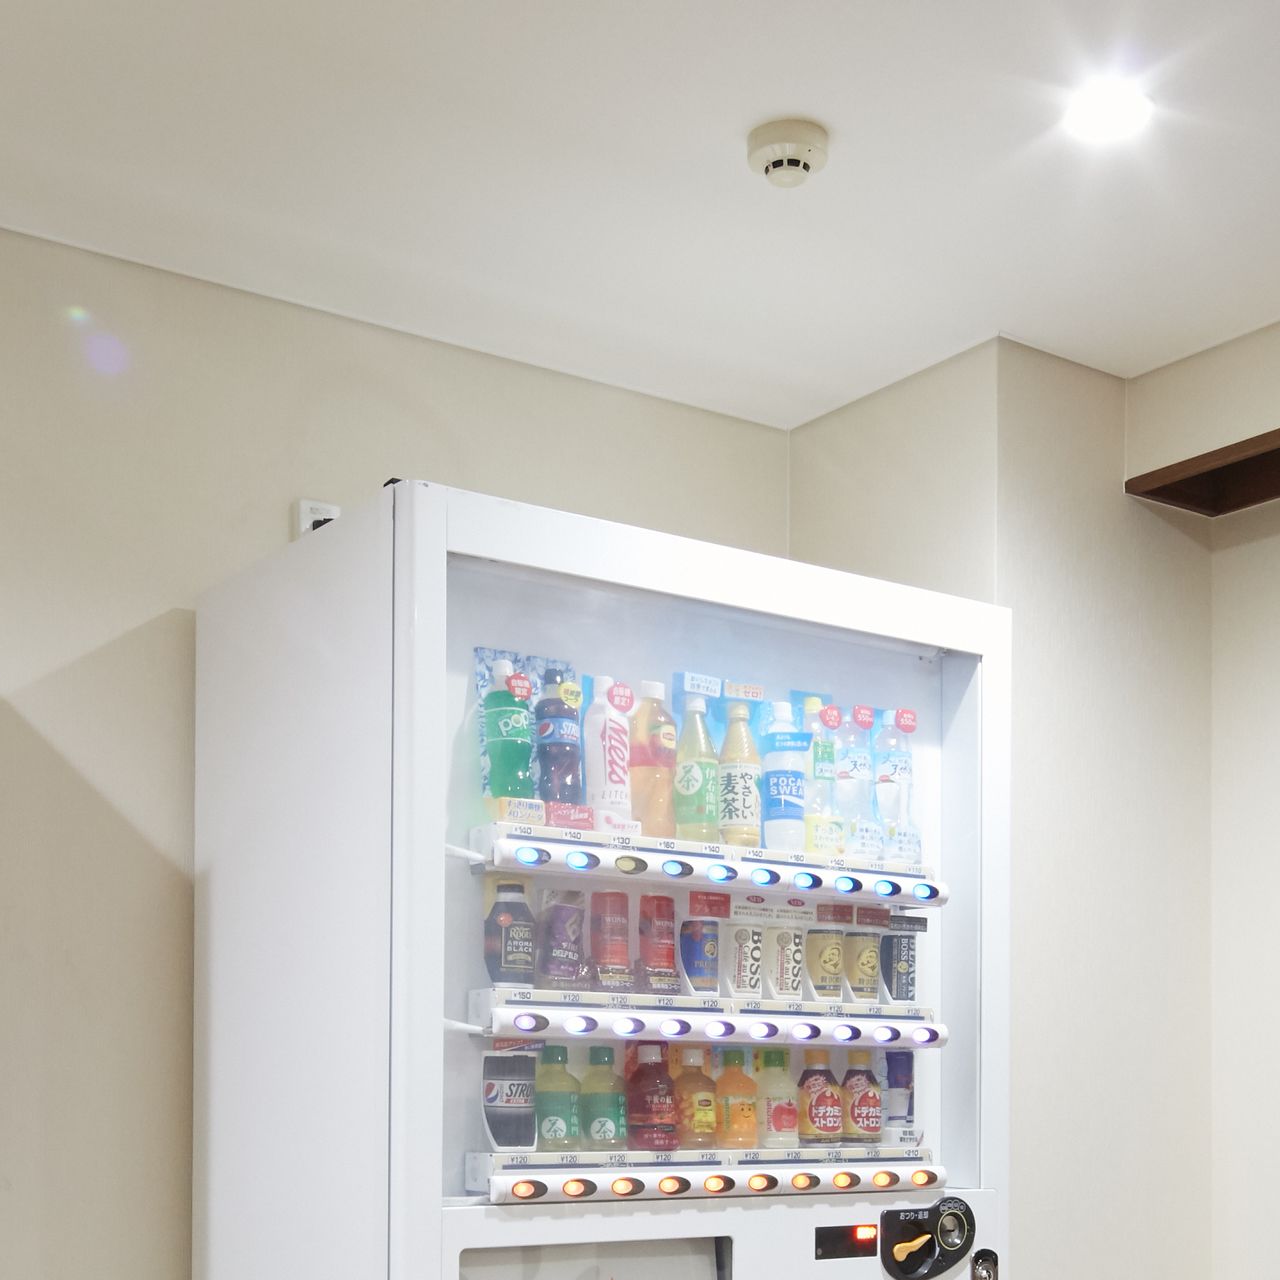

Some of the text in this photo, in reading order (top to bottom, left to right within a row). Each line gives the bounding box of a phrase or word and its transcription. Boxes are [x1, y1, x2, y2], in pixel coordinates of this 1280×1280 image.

[678, 764, 699, 792] 茶
[720, 772, 740, 820] 麦茶
[740, 772, 754, 819] やさしい
[613, 837, 631, 845] ¥130
[901, 938, 909, 961] BOSS
[749, 929, 762, 990] BOSS
[791, 932, 802, 992] BOSS
[513, 991, 531, 1000] ¥150
[563, 993, 580, 1001] ¥120
[611, 996, 627, 1005] ¥120
[658, 998, 674, 1006] ¥120
[703, 1000, 718, 1008] ¥120
[747, 1001, 761, 1009] ¥120
[788, 1002, 802, 1010] ¥120
[829, 1005, 843, 1013] ¥120
[869, 1006, 882, 1014] ¥120
[545, 1119, 564, 1139] 茶
[595, 1120, 613, 1139] 茶
[609, 1154, 625, 1162] ¥120
[656, 1153, 671, 1161] ¥120
[745, 1152, 759, 1160] ¥120
[787, 1151, 800, 1159] ¥120
[866, 1150, 880, 1158] ¥120
[561, 1155, 577, 1163] ¥120
